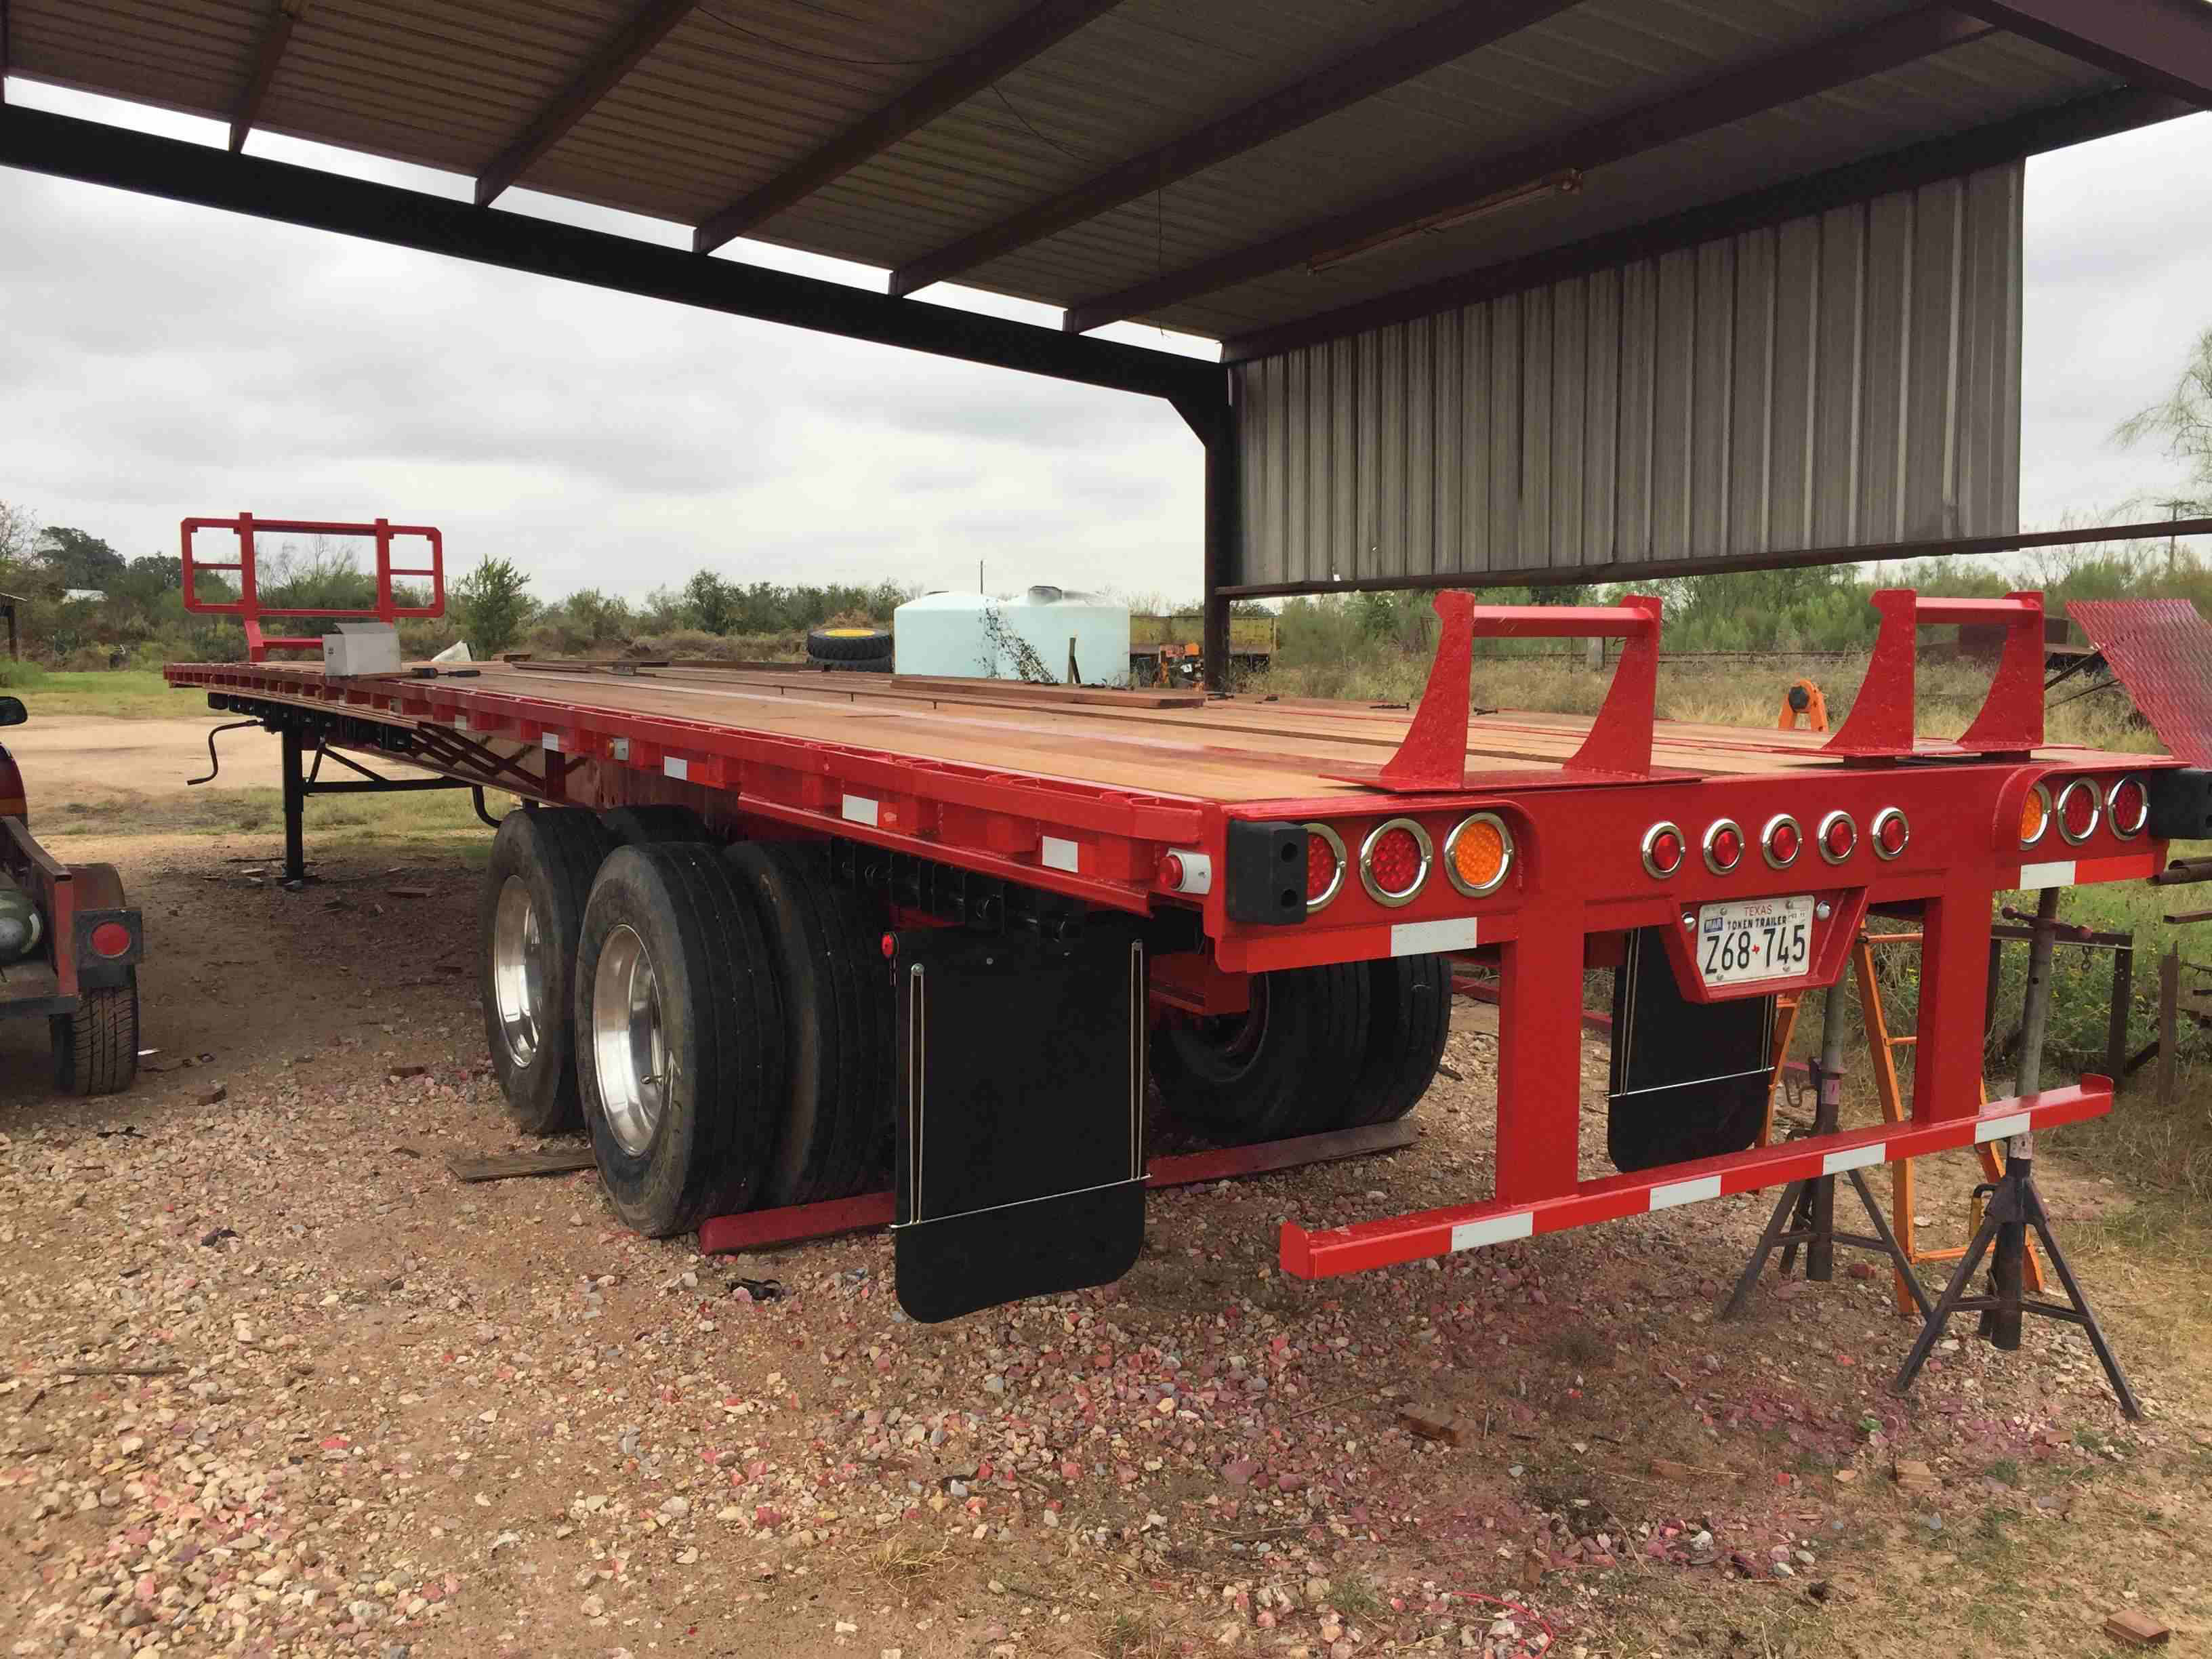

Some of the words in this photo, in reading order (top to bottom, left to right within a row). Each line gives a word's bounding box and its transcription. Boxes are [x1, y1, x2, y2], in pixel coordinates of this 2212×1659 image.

[1744, 905, 1773, 916] TEXAS
[1727, 918, 1753, 931] TOKEN
[1756, 916, 1786, 928] TRAILER
[1705, 931, 1751, 975] Z68
[1763, 924, 1805, 968] 745
